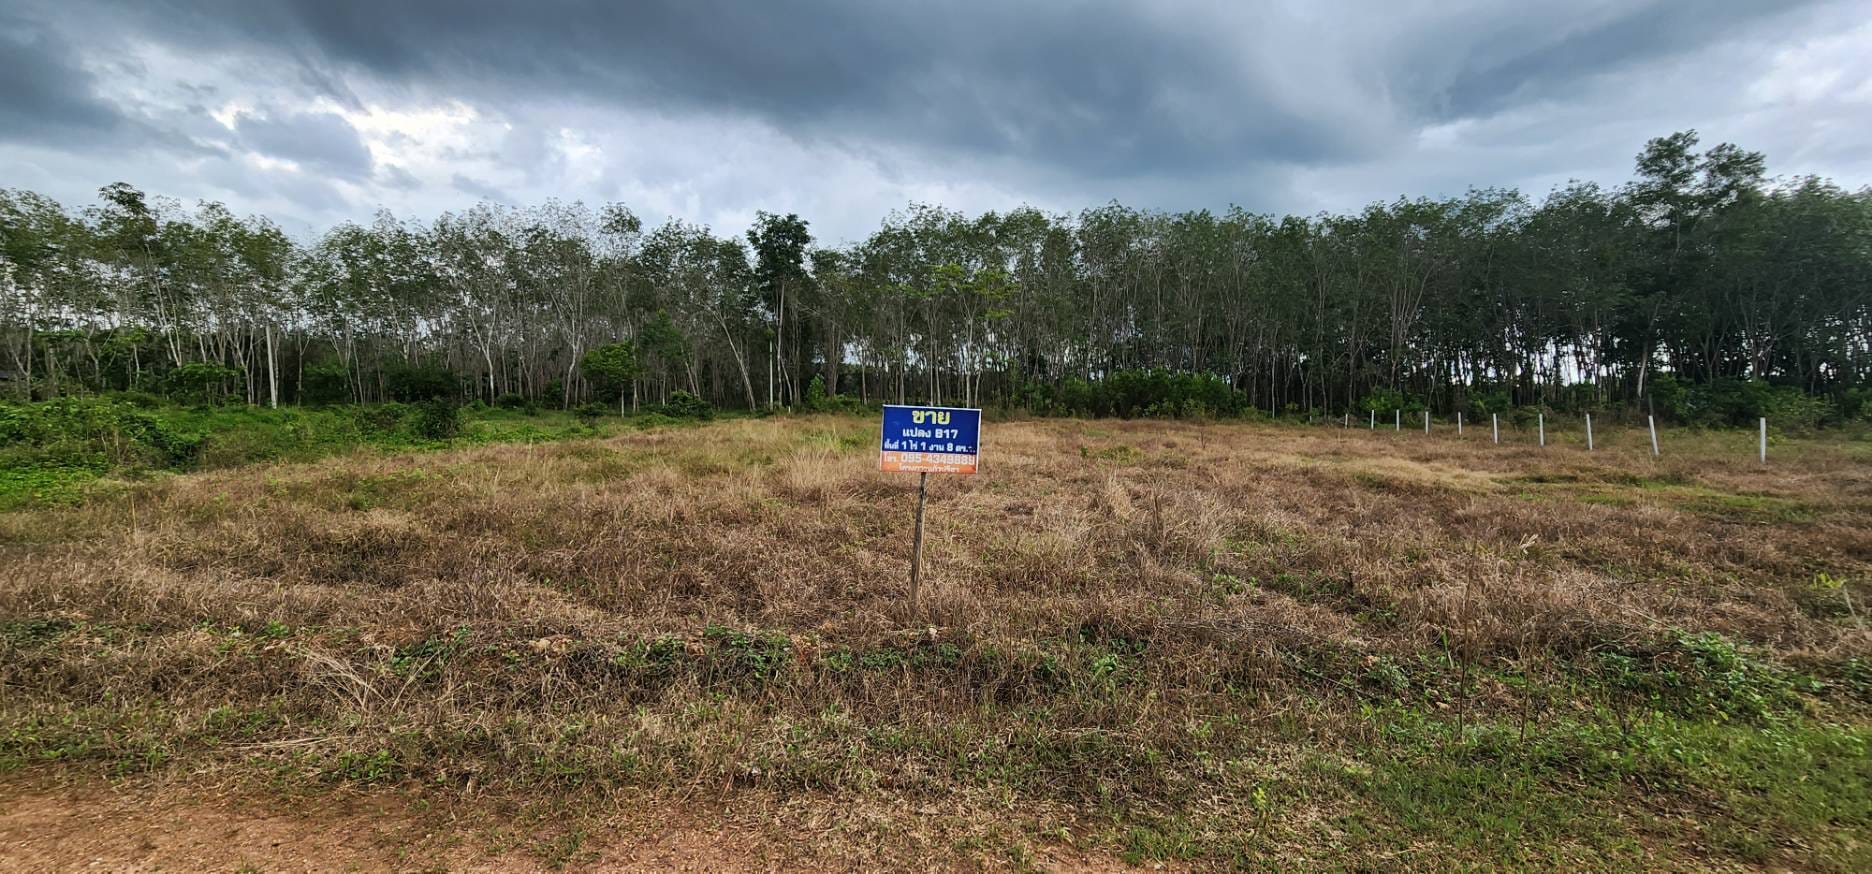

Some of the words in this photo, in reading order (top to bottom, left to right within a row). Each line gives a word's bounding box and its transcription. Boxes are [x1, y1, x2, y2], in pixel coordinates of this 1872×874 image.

[912, 410, 950, 425] ขาย
[902, 427, 931, 438] แปลง
[935, 428, 958, 439] B17
[901, 440, 907, 450] 1
[920, 441, 926, 451] 1
[928, 443, 945, 451] งาน
[946, 442, 954, 452] 8
